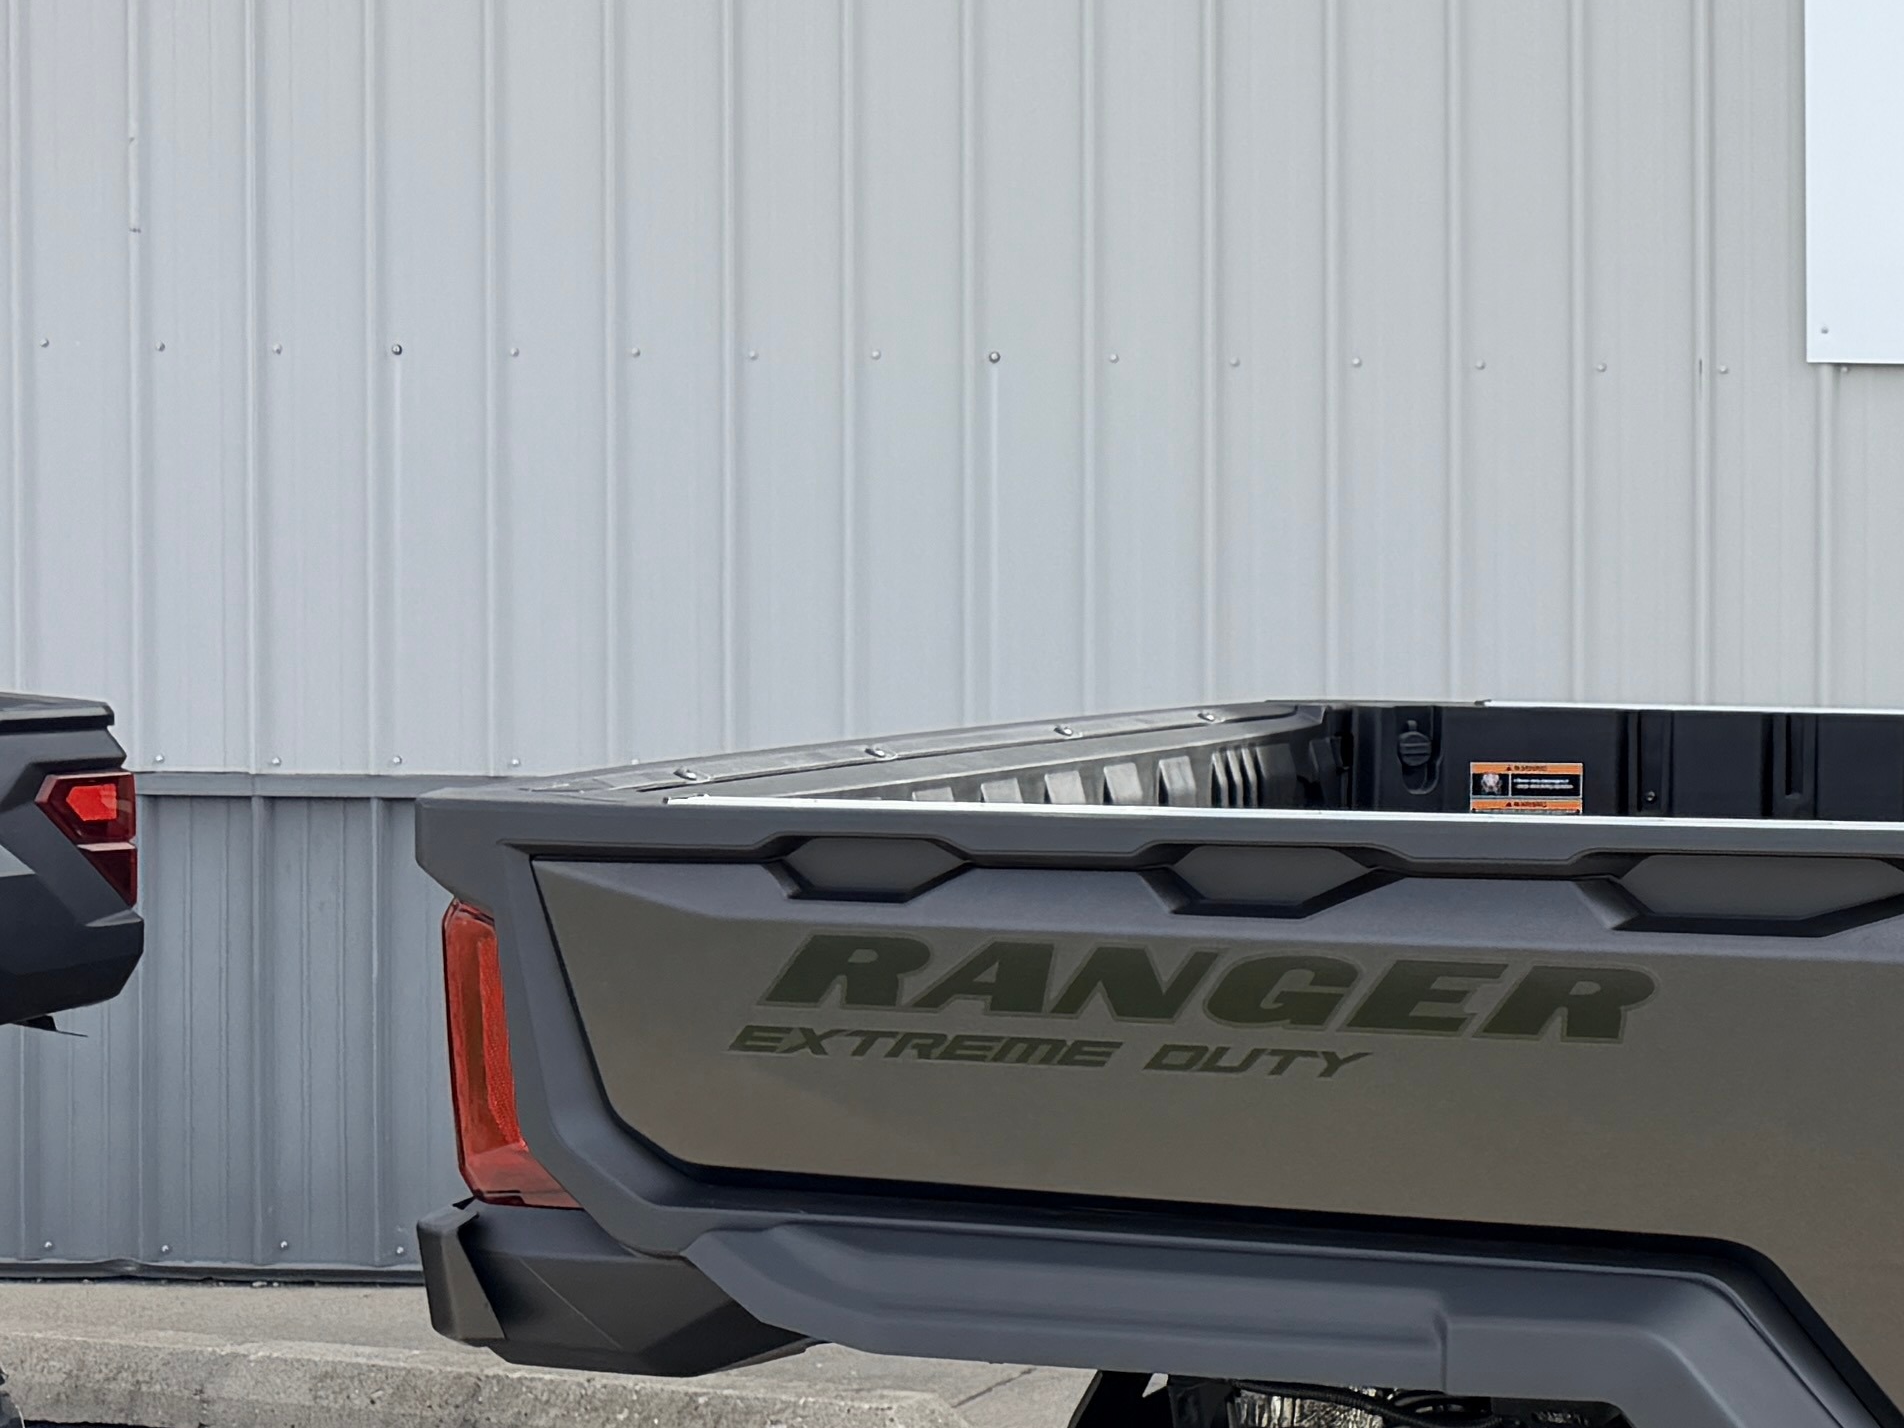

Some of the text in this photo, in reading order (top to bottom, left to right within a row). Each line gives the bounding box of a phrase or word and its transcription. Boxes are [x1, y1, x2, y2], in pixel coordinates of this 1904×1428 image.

[761, 931, 1661, 1045] RANGER
[728, 1024, 1374, 1079] EXTREME DUTY
